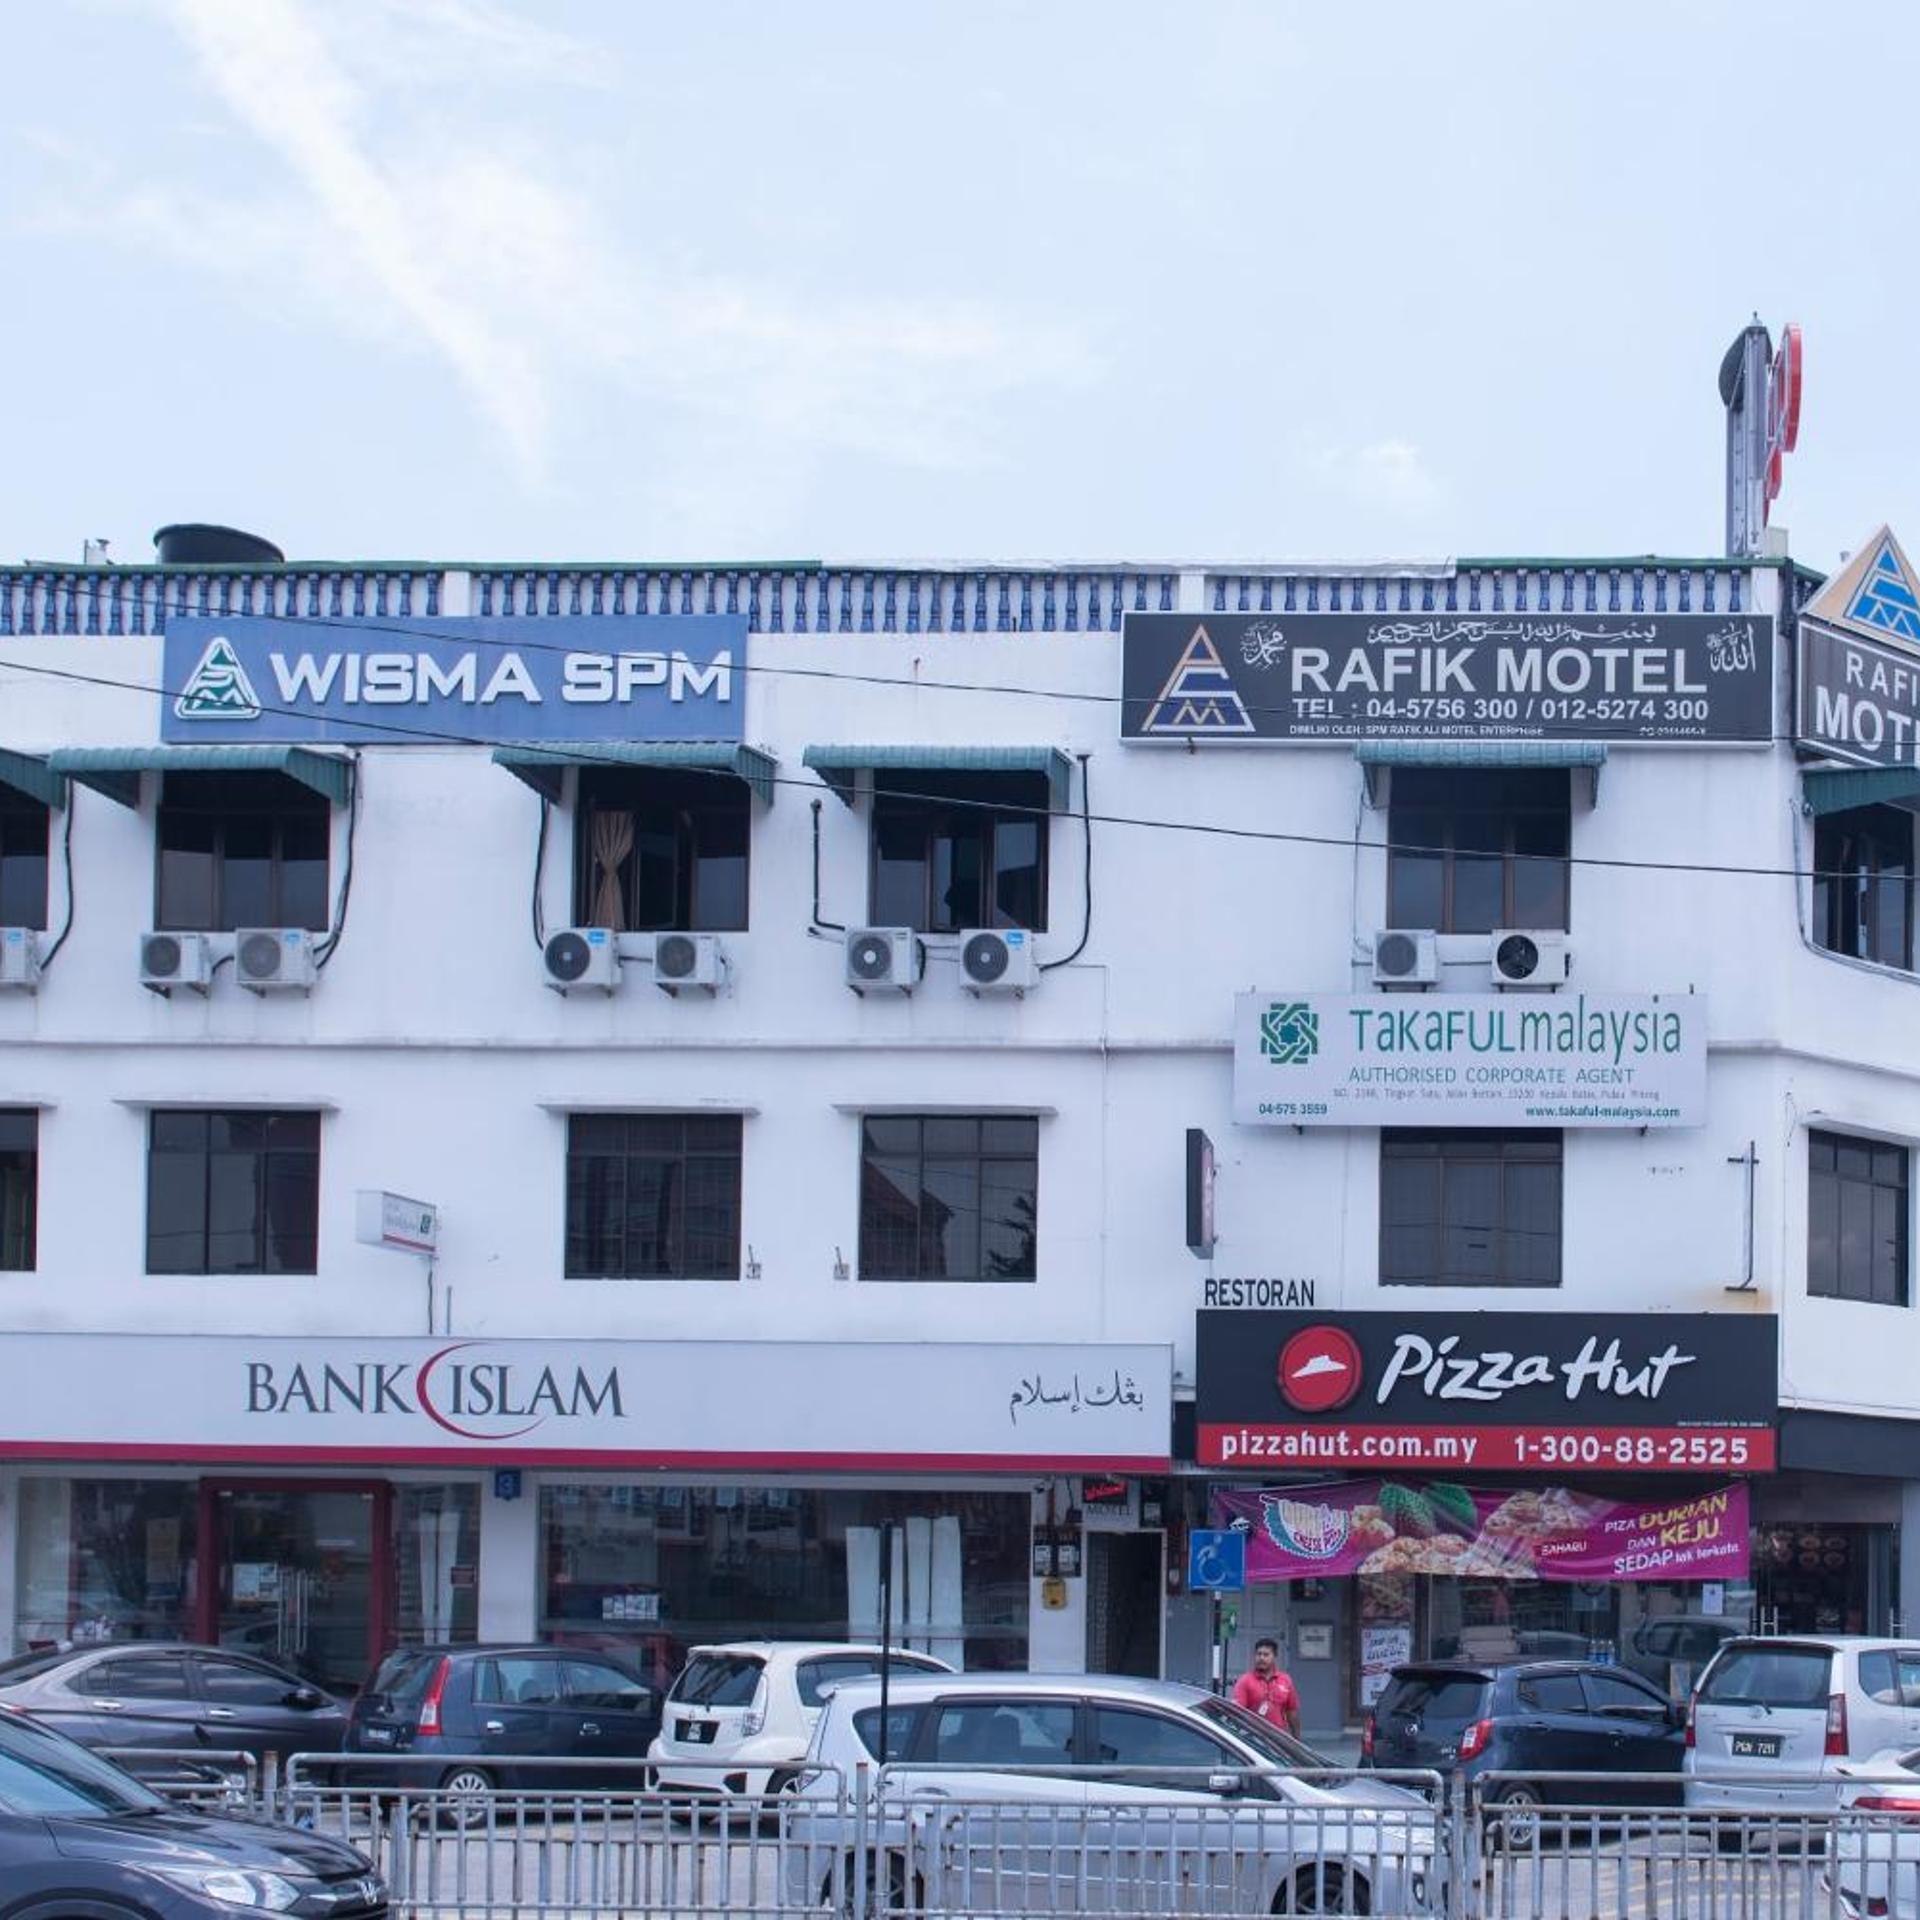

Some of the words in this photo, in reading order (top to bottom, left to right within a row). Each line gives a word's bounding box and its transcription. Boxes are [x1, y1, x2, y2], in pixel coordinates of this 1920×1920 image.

[269, 652, 541, 704] WISMA
[562, 650, 731, 703] SPM
[1291, 647, 1476, 693] RAFIK
[1497, 647, 1708, 694] MOTEL
[1366, 698, 1467, 719] 04-5756
[1473, 698, 1518, 720] 300
[1541, 700, 1655, 720] 012-5274
[1664, 700, 1709, 720] 300
[1816, 685, 1920, 770] MOT
[1349, 1067, 1457, 1084] AUTHORISED
[1466, 1067, 1566, 1084] CORPORATE
[1576, 1067, 1635, 1084] AGENT
[1526, 1105, 1680, 1119] www.takaful-malaysia.com
[1205, 1279, 1314, 1306] RESTORAN
[1377, 1334, 1555, 1404] Pizza
[1561, 1335, 1696, 1399] Hut
[245, 1362, 416, 1414] BANK
[447, 1363, 627, 1418] ISLAM
[1222, 1430, 1477, 1463] pizzahut.com.my
[1514, 1435, 1749, 1464] 1-300-88-2525
[1639, 1492, 1728, 1530] DURIAN
[1660, 1517, 1720, 1547] KEJU
[1613, 1549, 1673, 1574] SEDAP
